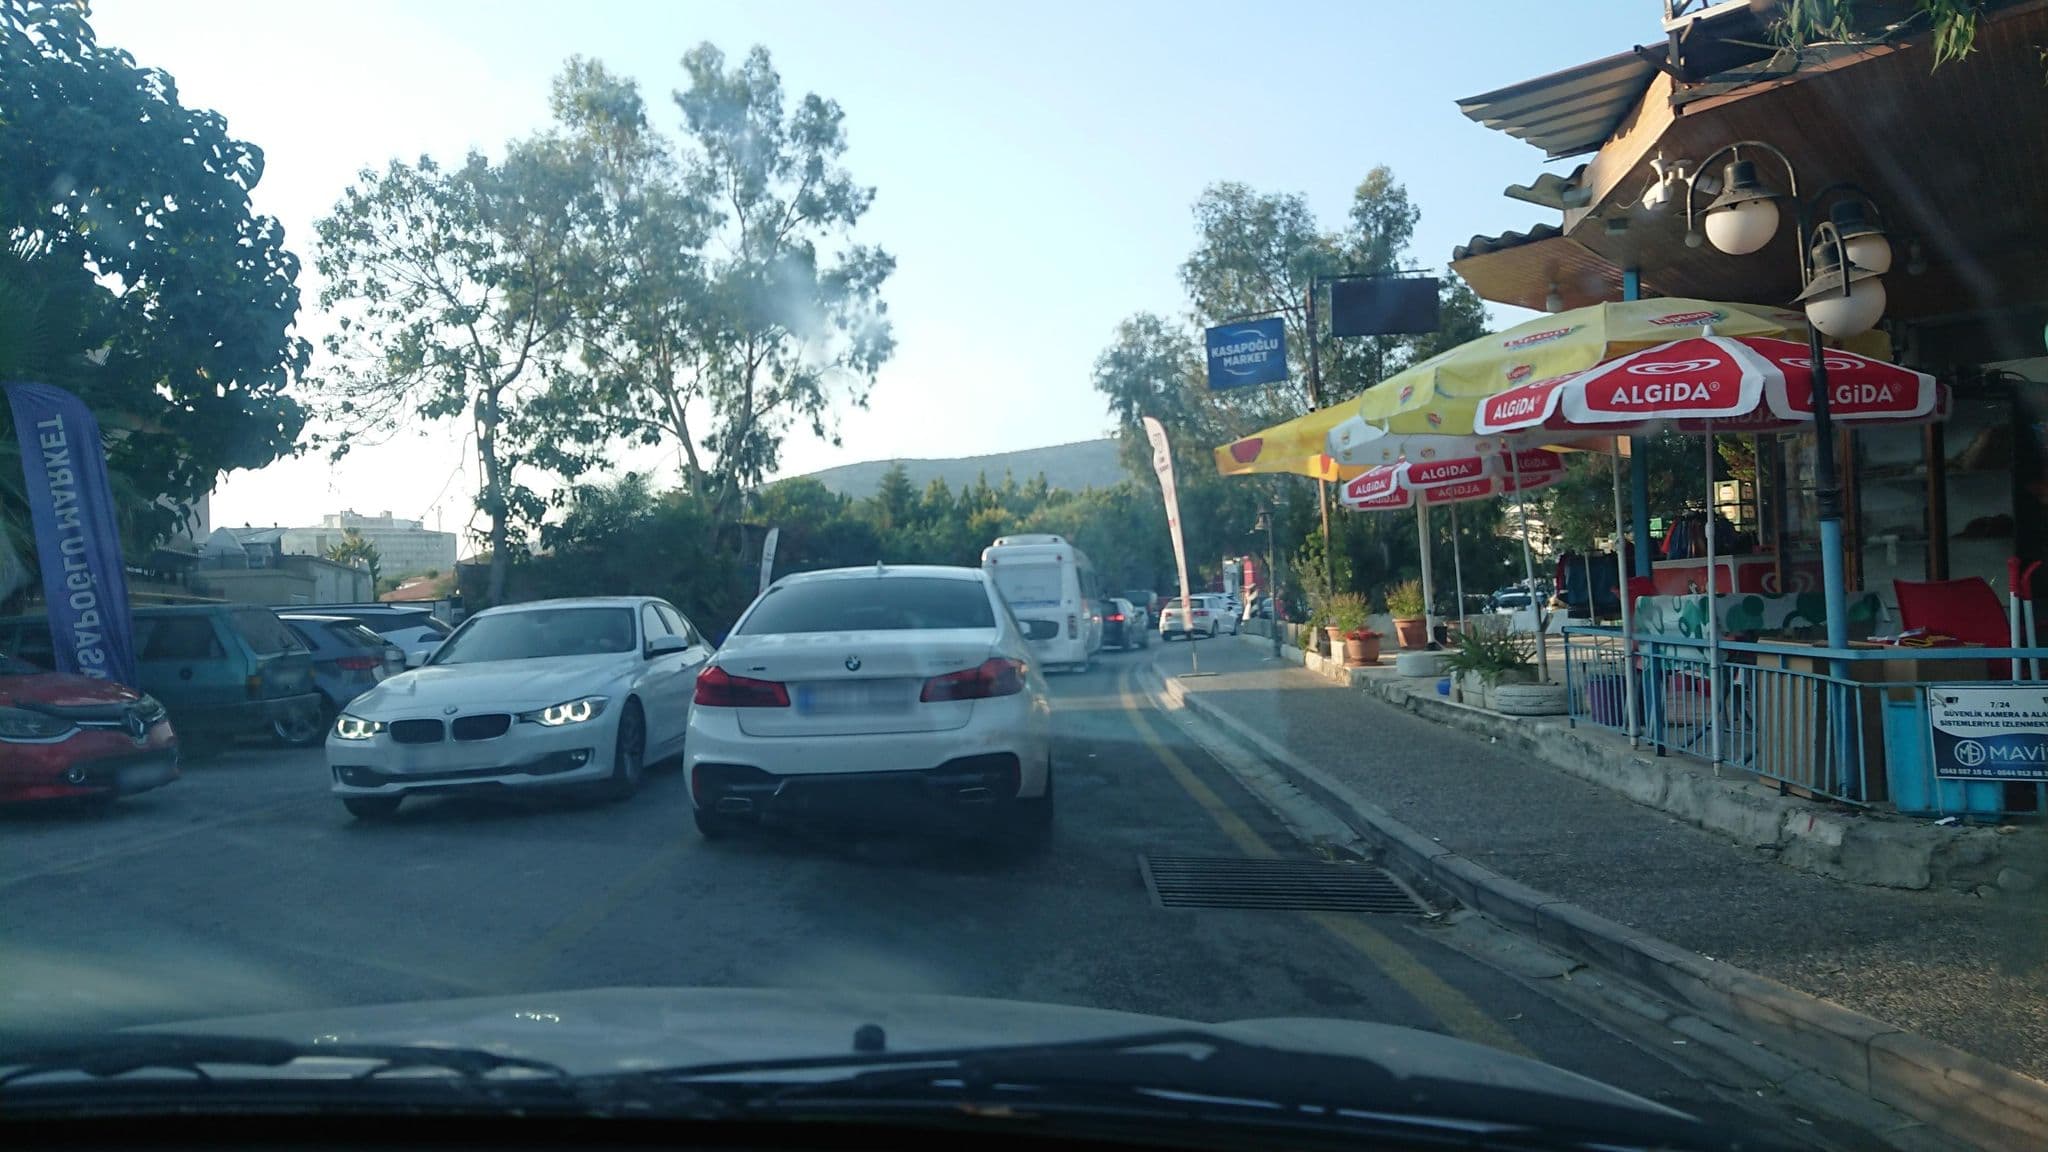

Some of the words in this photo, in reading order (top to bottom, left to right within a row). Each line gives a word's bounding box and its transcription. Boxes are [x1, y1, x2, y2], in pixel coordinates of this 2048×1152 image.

[1211, 339, 1279, 358] KASAPOĞLU
[1224, 352, 1267, 367] MARKET
[1989, 743, 2048, 761] MAVİ
